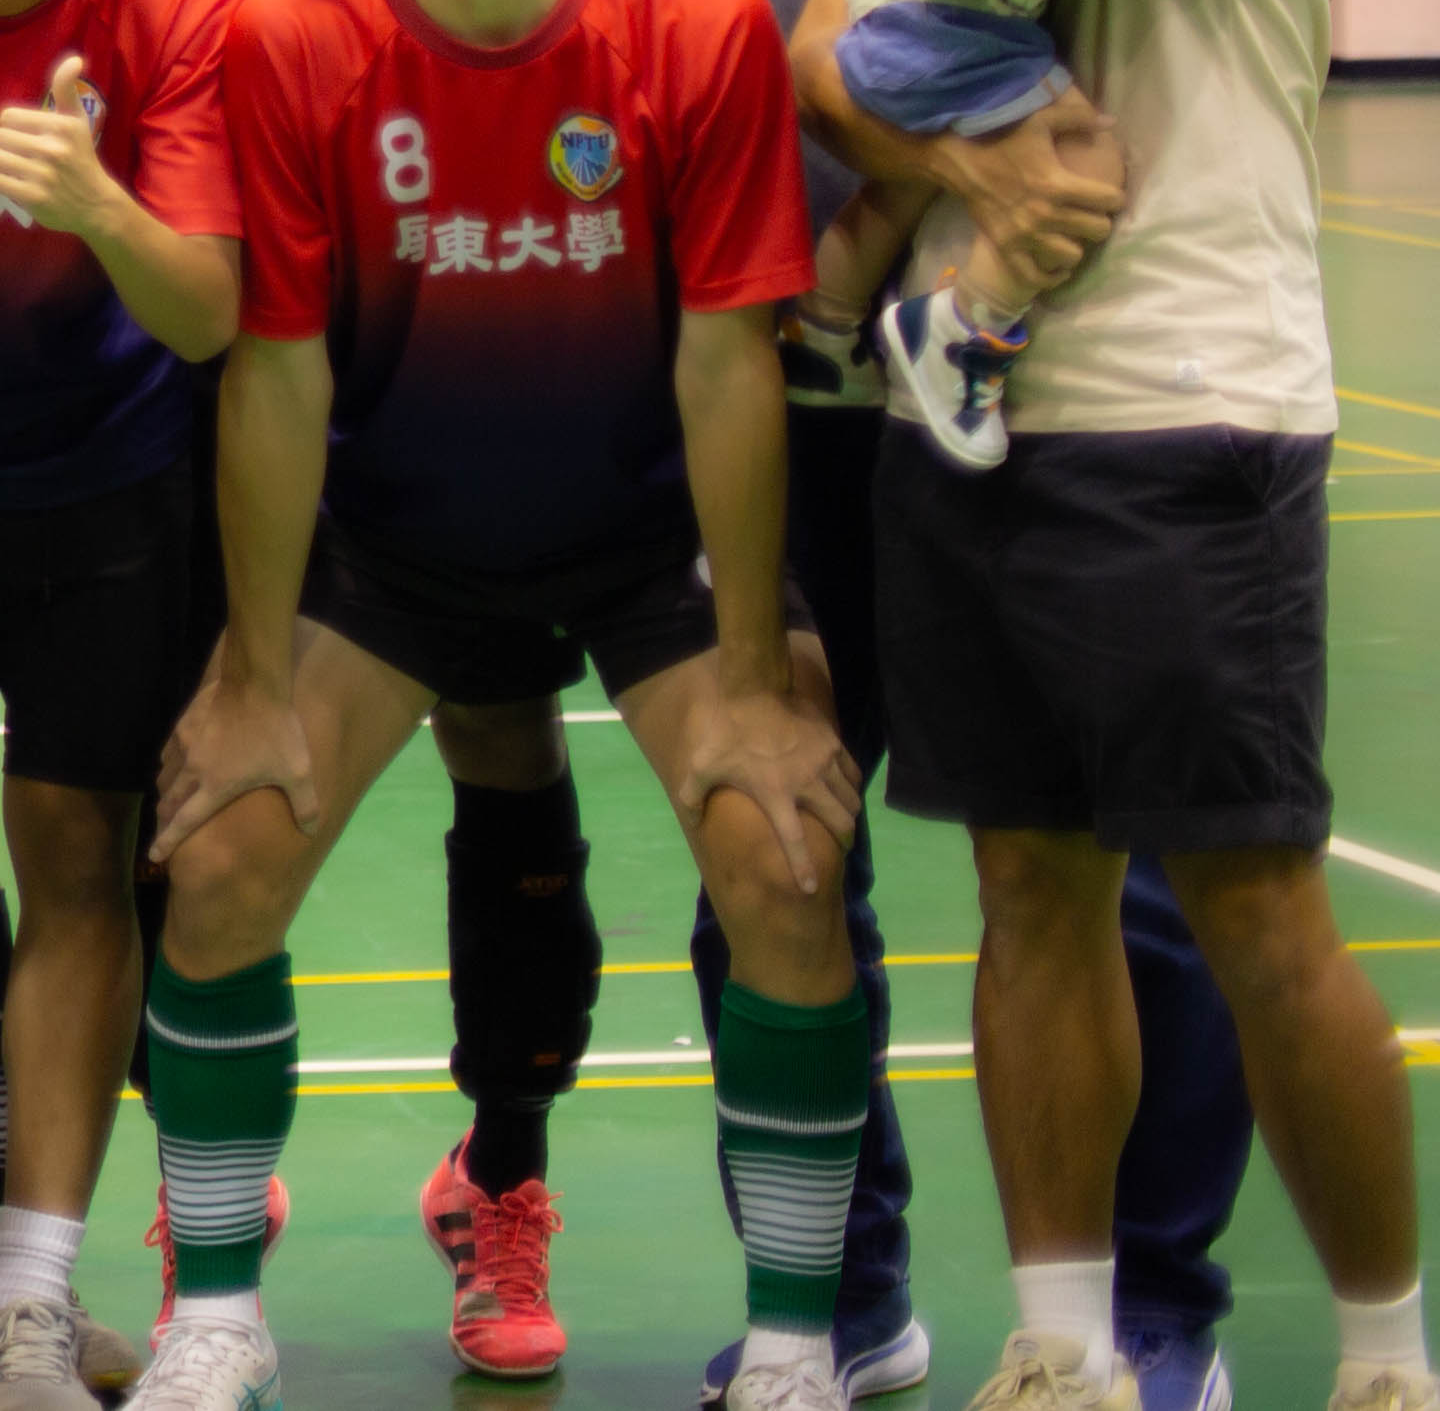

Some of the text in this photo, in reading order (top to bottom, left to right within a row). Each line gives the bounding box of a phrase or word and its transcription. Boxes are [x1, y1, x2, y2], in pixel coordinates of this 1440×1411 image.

[380, 116, 430, 204] 8
[395, 209, 626, 276] 屏東大學
